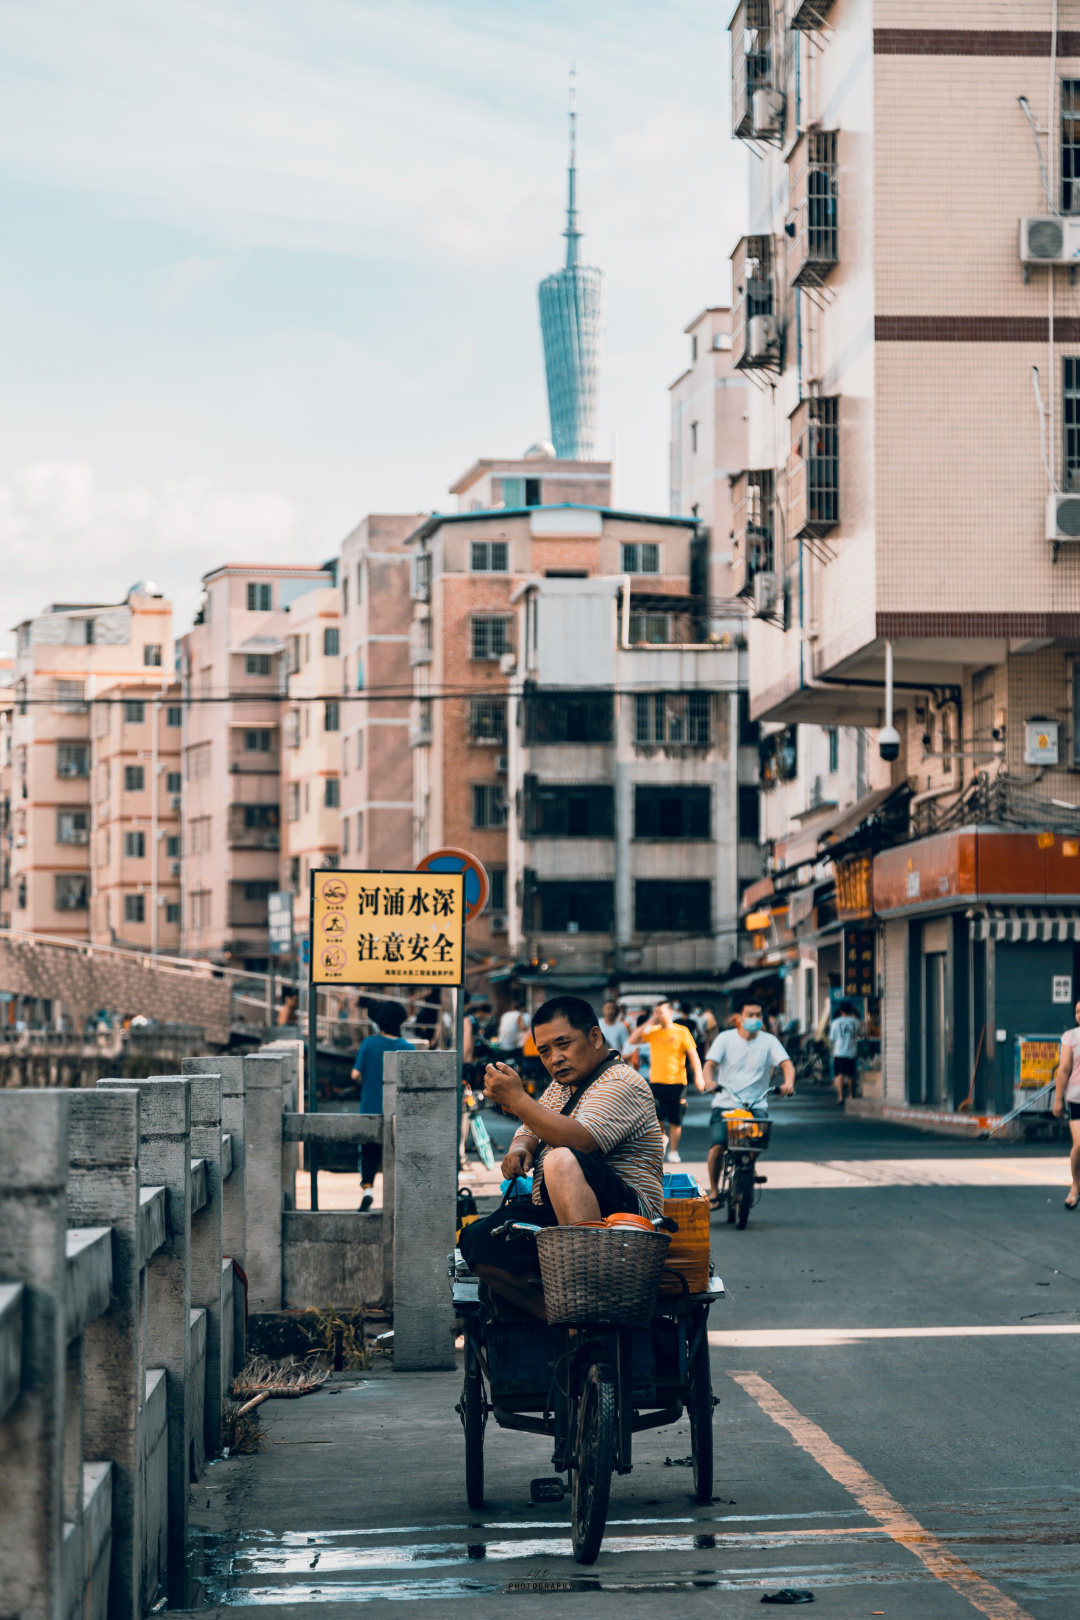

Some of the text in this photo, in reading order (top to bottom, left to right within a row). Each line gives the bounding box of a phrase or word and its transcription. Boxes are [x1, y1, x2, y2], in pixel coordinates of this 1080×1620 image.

[358, 886, 455, 917] 河涌水深
[357, 931, 455, 963] 注意安全
